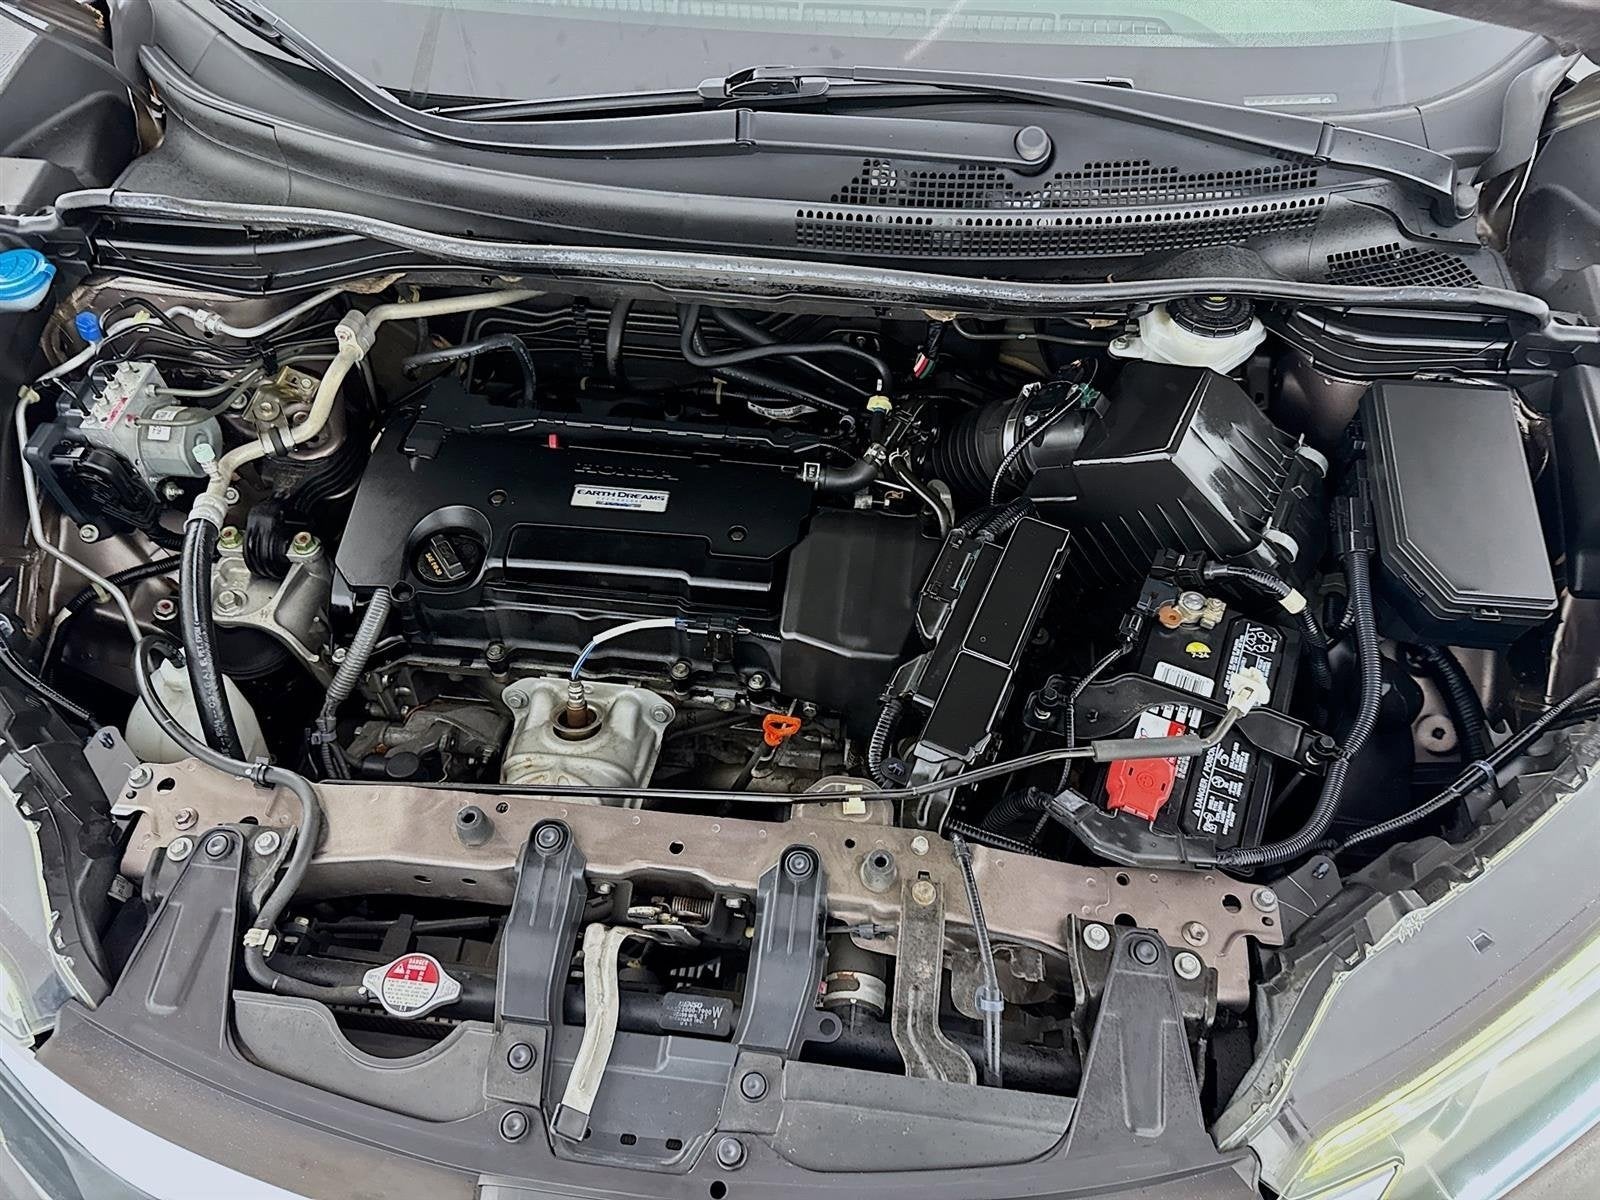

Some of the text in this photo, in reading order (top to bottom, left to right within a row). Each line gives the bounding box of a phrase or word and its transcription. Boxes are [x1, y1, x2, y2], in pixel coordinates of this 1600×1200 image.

[577, 488, 616, 498] EARTH
[617, 491, 665, 501] DREAMS
[1194, 777, 1207, 808] DANGER
[1202, 746, 1216, 772] POISON
[712, 1006, 724, 1018] W
